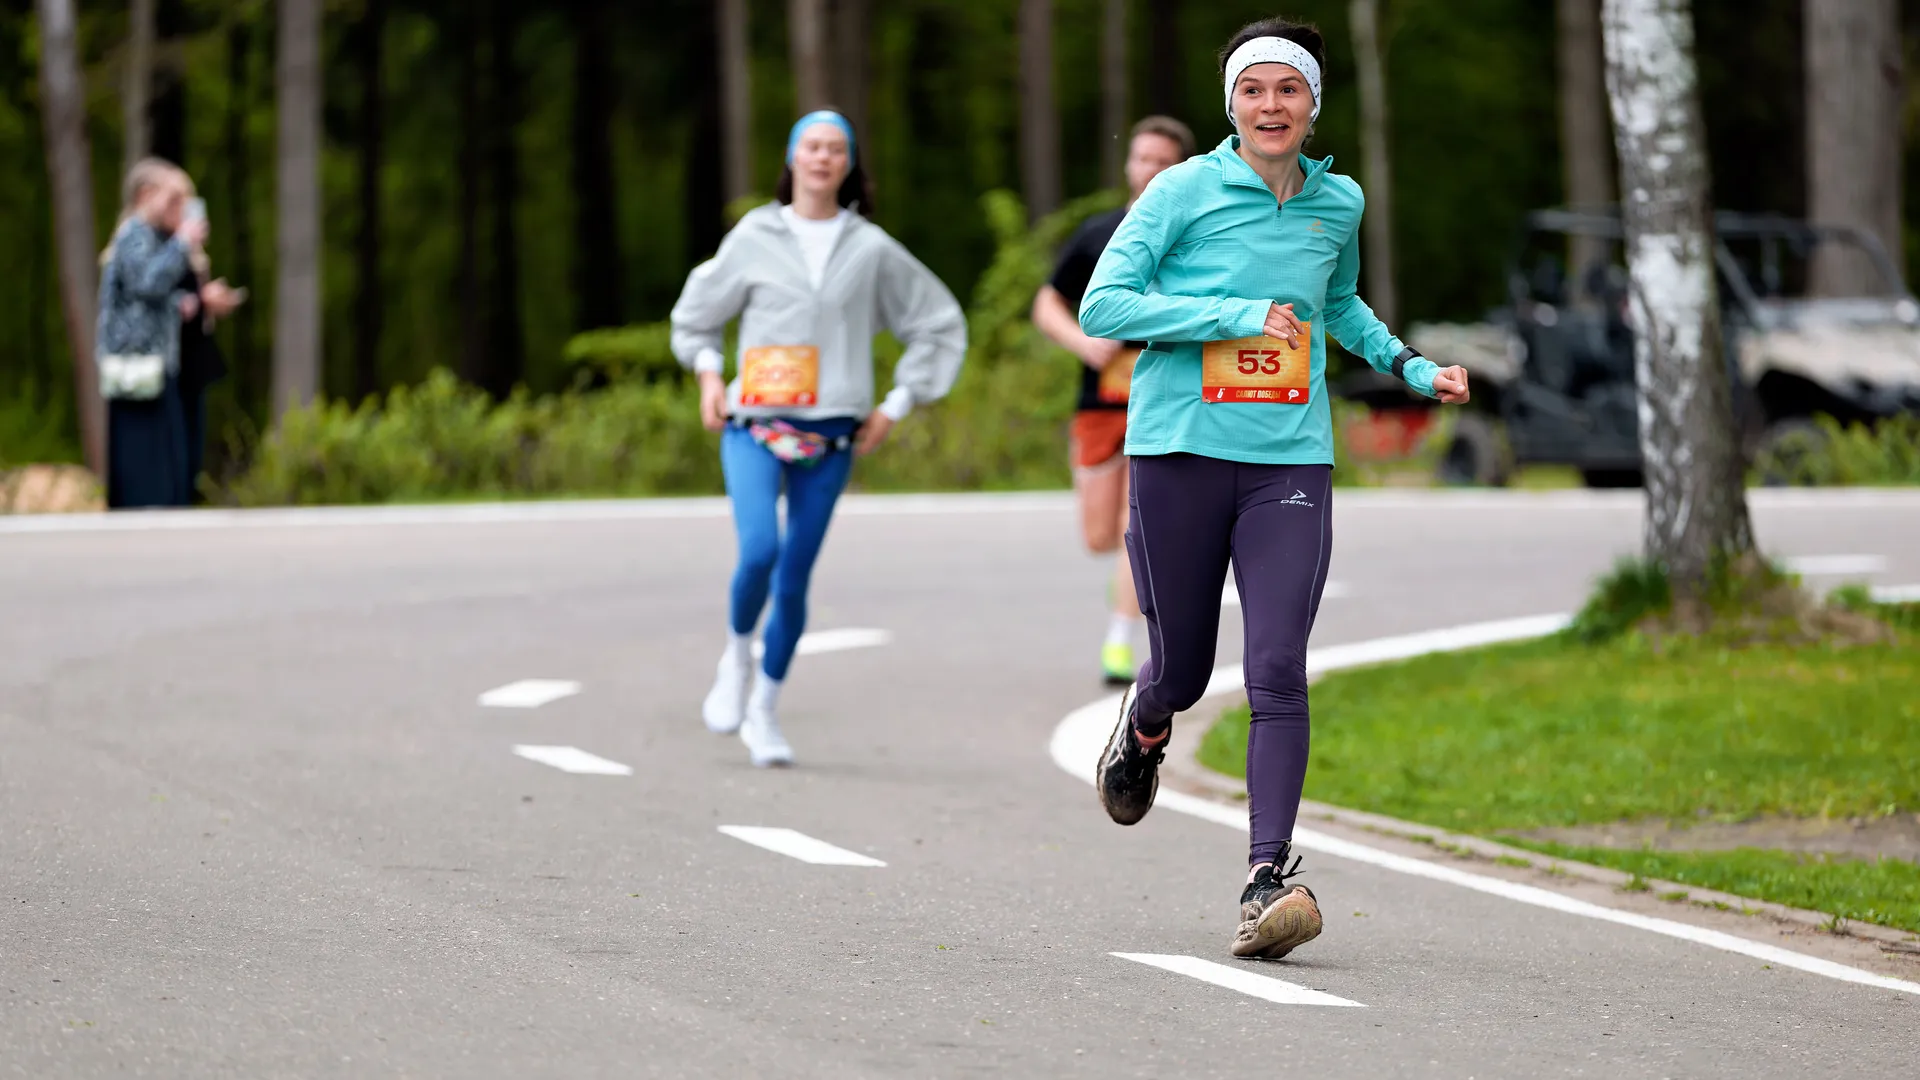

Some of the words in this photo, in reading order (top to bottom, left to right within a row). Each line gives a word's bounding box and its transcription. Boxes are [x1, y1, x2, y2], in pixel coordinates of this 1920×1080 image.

[1237, 350, 1281, 375] 53
[1257, 390, 1281, 400] ПОБЕДЫ
[1280, 499, 1315, 508] DEMIX
